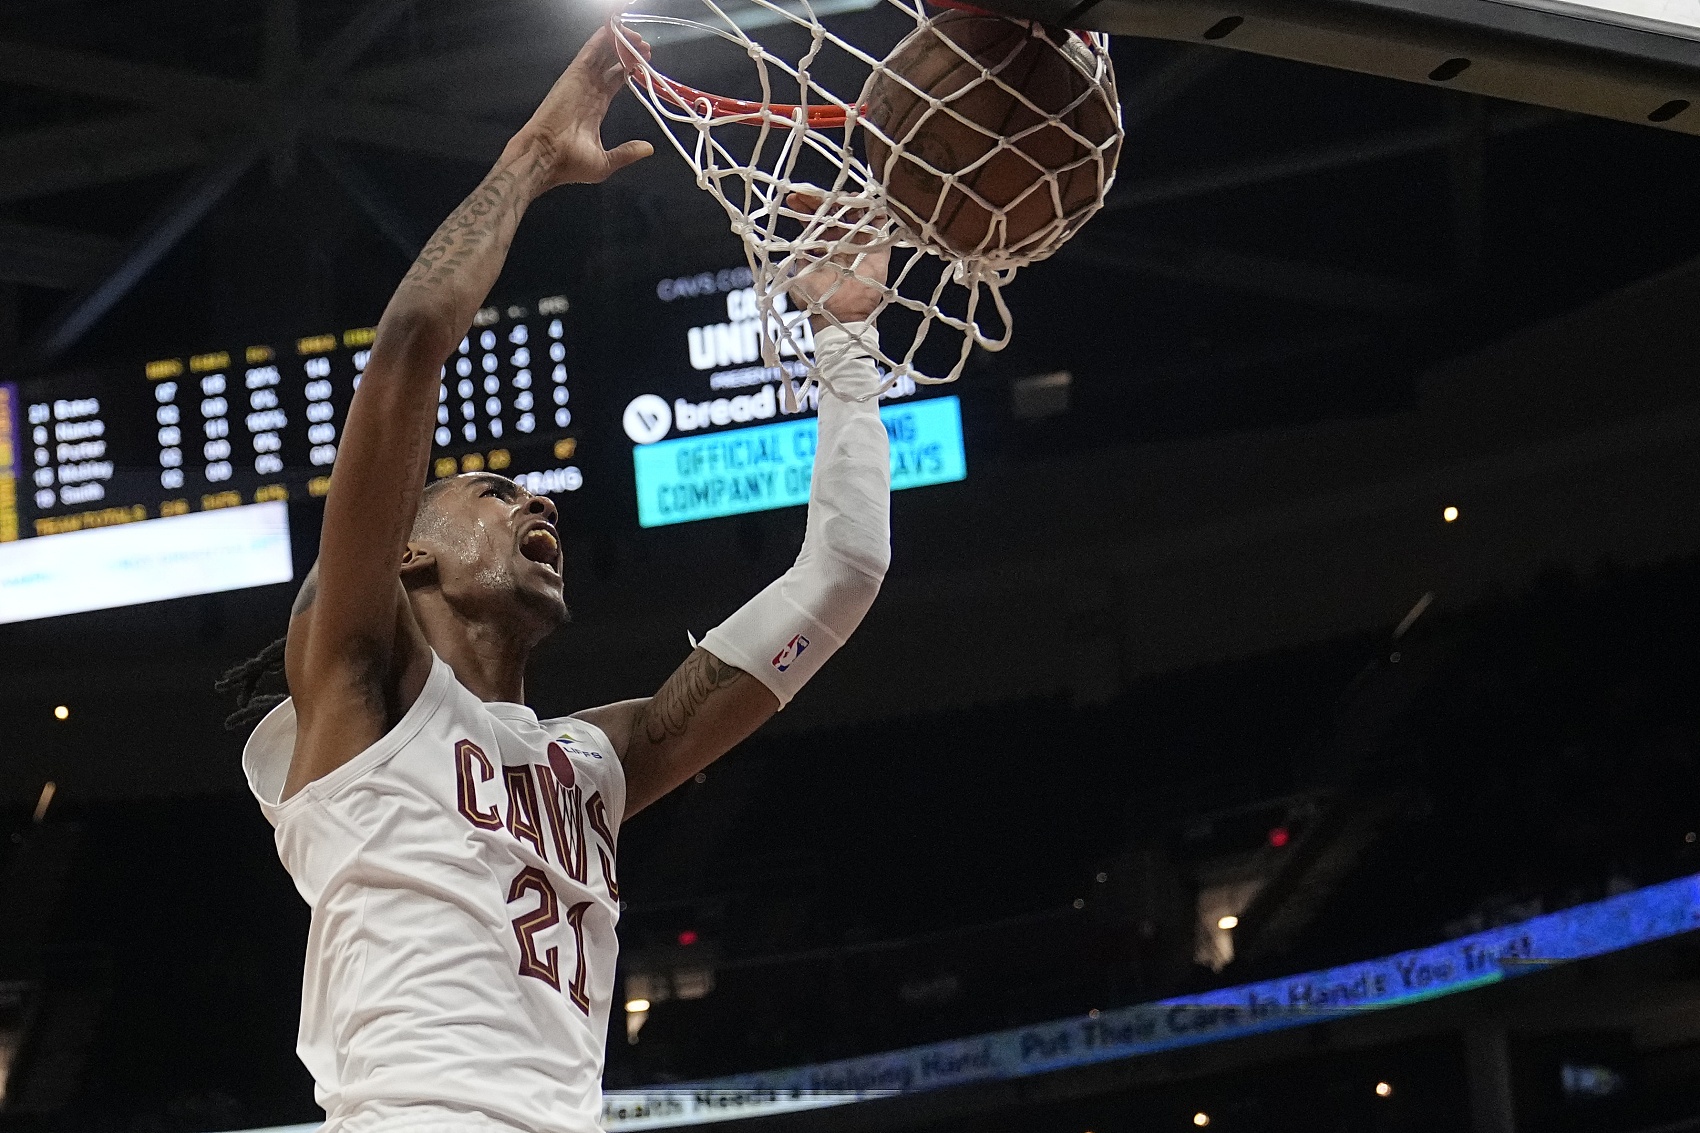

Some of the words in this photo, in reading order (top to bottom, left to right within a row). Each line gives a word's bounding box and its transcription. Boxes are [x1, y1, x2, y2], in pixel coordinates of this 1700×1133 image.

[675, 433, 784, 477] OFFICIAL
[657, 470, 776, 516] COMPANY
[506, 865, 595, 1018] 21
[1396, 954, 1453, 988] You
